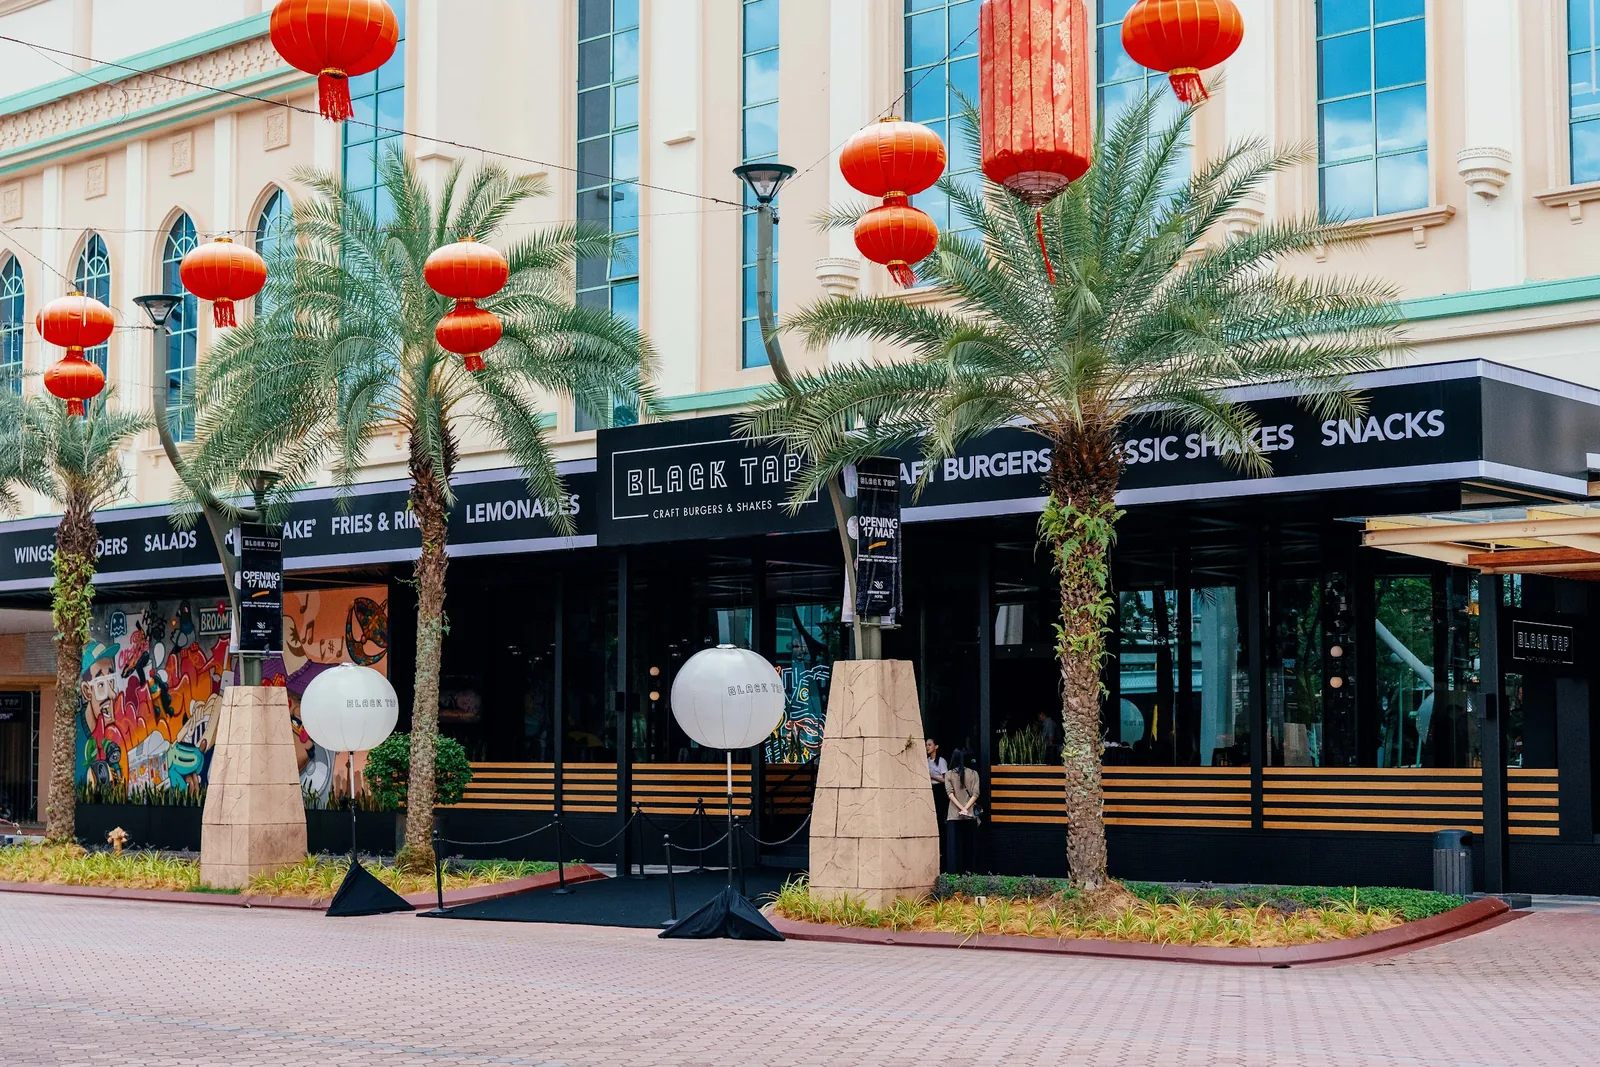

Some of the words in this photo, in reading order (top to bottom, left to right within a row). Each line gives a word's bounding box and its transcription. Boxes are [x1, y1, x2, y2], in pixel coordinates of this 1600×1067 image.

[1321, 409, 1445, 447] SNACKS
[1122, 435, 1179, 465] SSIC
[944, 448, 1052, 482] BURGERS
[627, 460, 728, 497] BLACK
[740, 453, 802, 487] TAP
[860, 476, 882, 486] BLACK
[883, 478, 896, 487] TAP
[653, 507, 680, 519] CRAFT
[683, 504, 723, 517] BURGERS
[726, 503, 733, 513] &
[736, 500, 773, 512] SHAKES
[331, 512, 373, 536] FRIES
[377, 511, 390, 532] &
[859, 515, 898, 529] OPENING
[144, 529, 197, 552] SALADS
[863, 526, 874, 538] 17
[875, 527, 895, 539] MAR
[95, 536, 129, 558] DERS
[244, 539, 266, 549] BLACK
[267, 540, 279, 549] TAP
[14, 544, 55, 564] WINGS
[242, 570, 280, 581] OPENING
[247, 579, 256, 589] 17
[258, 579, 277, 590] MAR
[1517, 631, 1550, 650] BLACK
[1551, 635, 1569, 651] TAP
[727, 683, 769, 697] BLACK
[346, 698, 383, 708] BLACK
